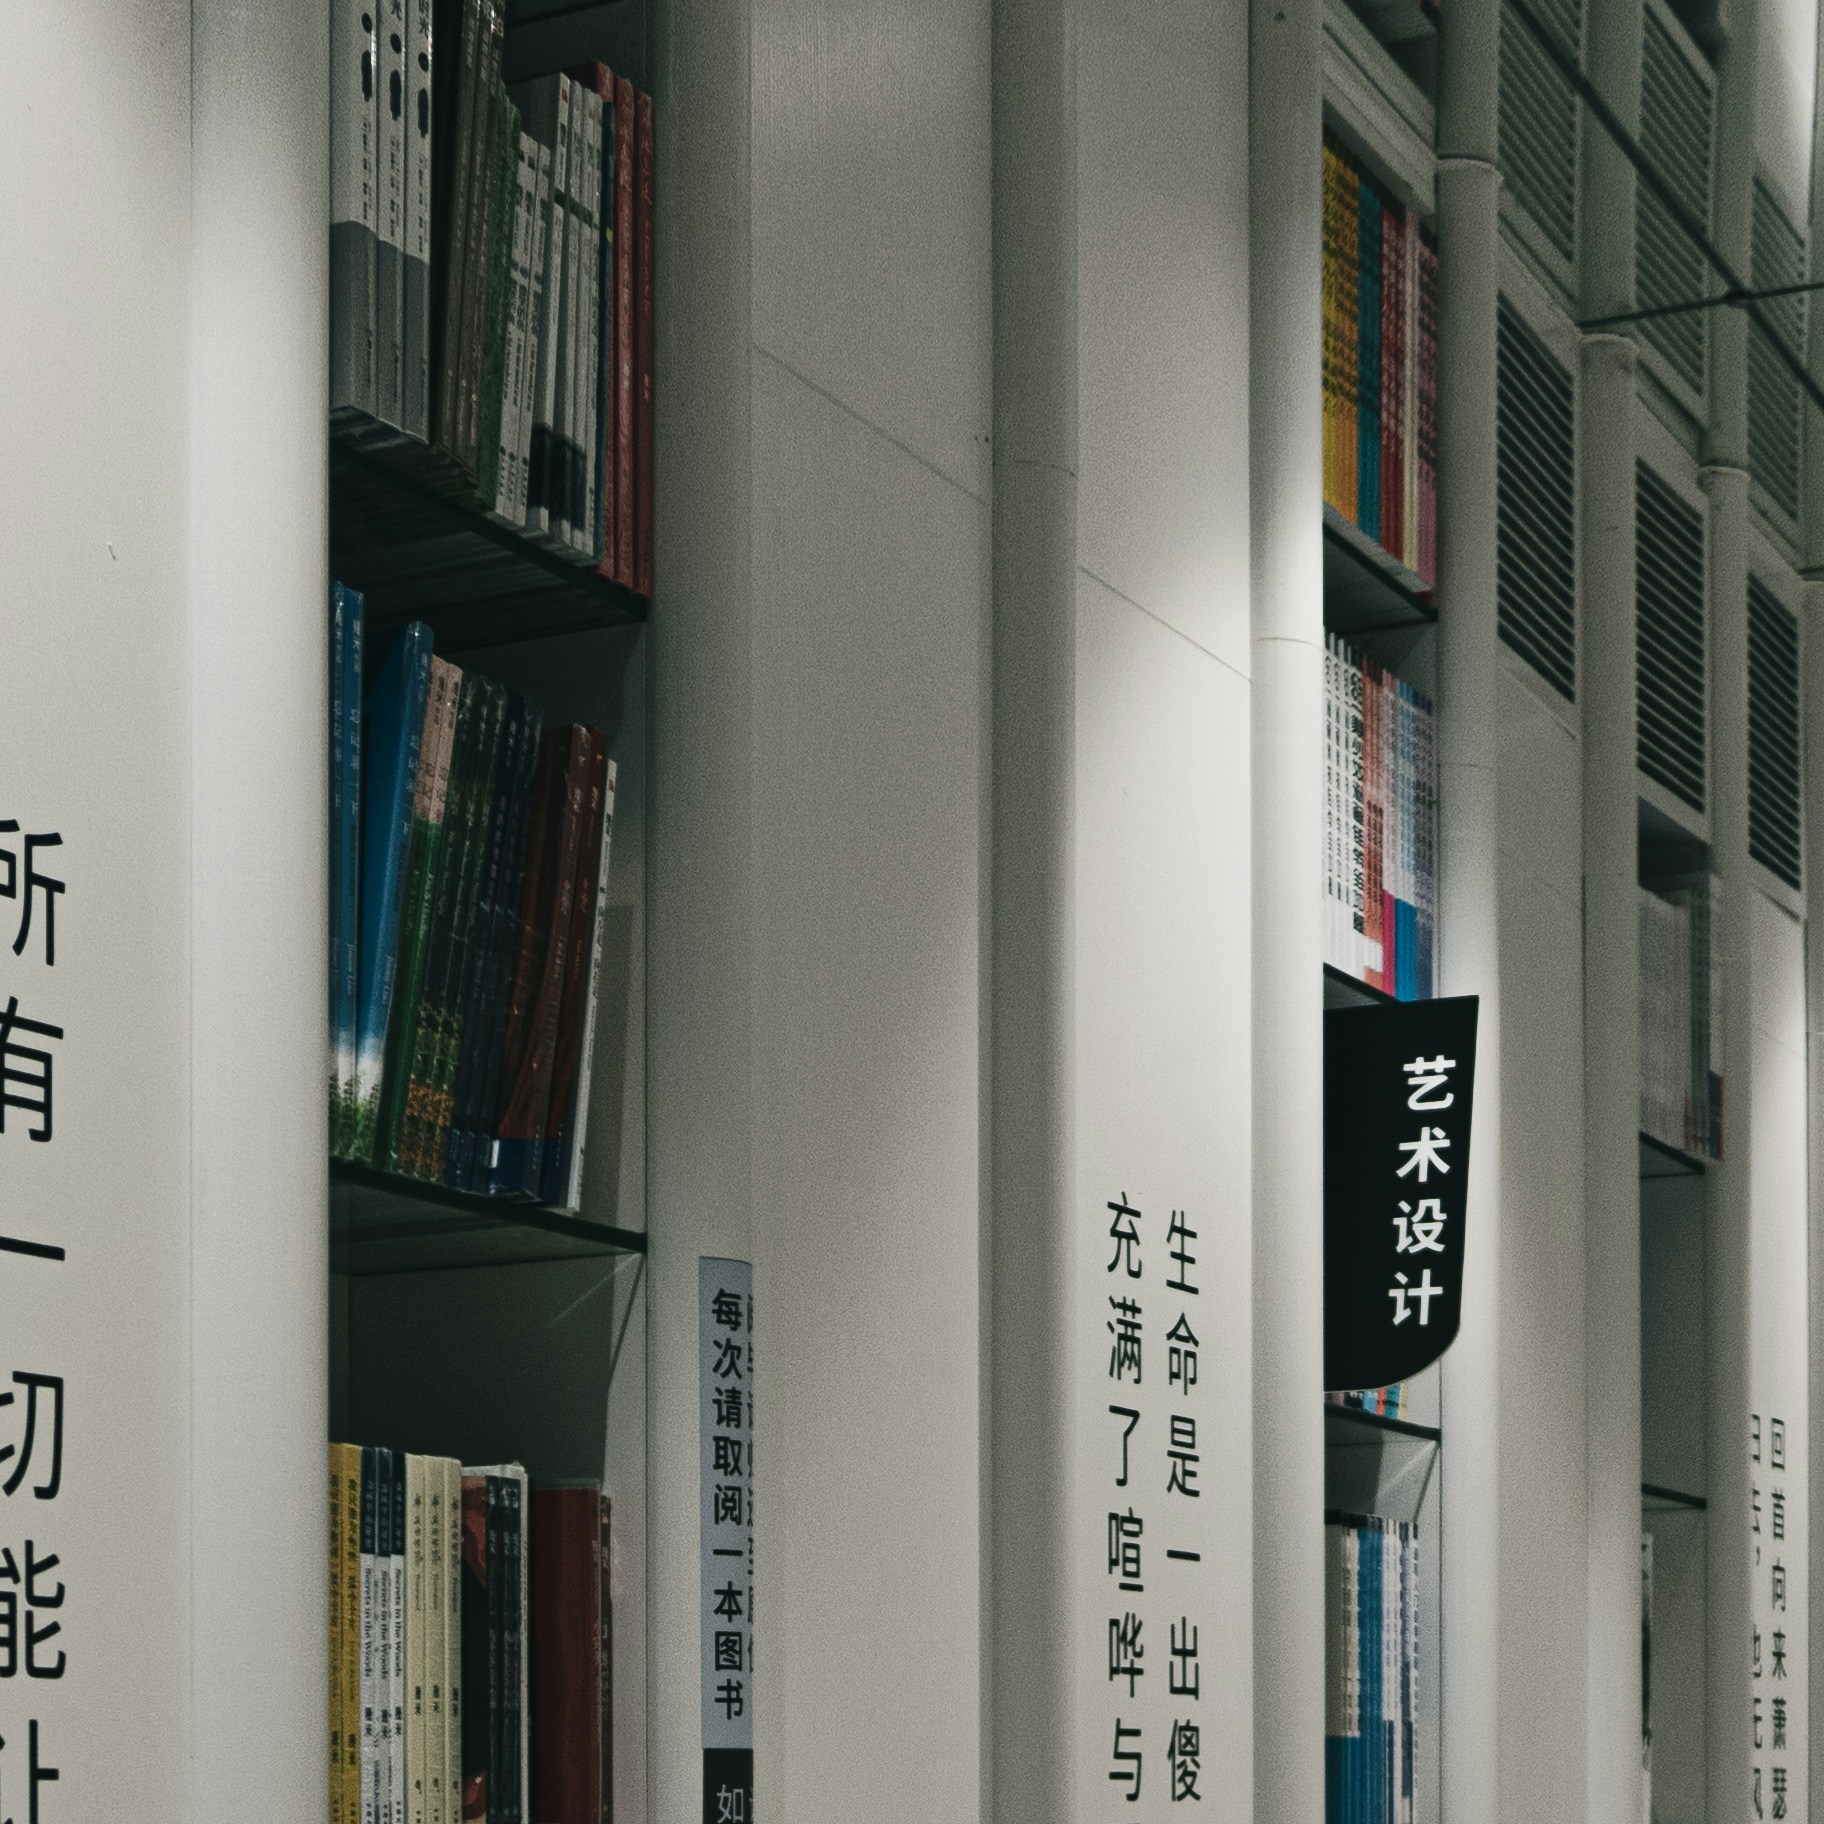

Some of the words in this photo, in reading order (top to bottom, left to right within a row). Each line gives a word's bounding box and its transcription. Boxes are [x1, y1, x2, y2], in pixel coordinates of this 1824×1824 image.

[1388, 1053, 1457, 1327] 艺术设计
[711, 1287, 744, 1721] 每次请取阅一本图书
